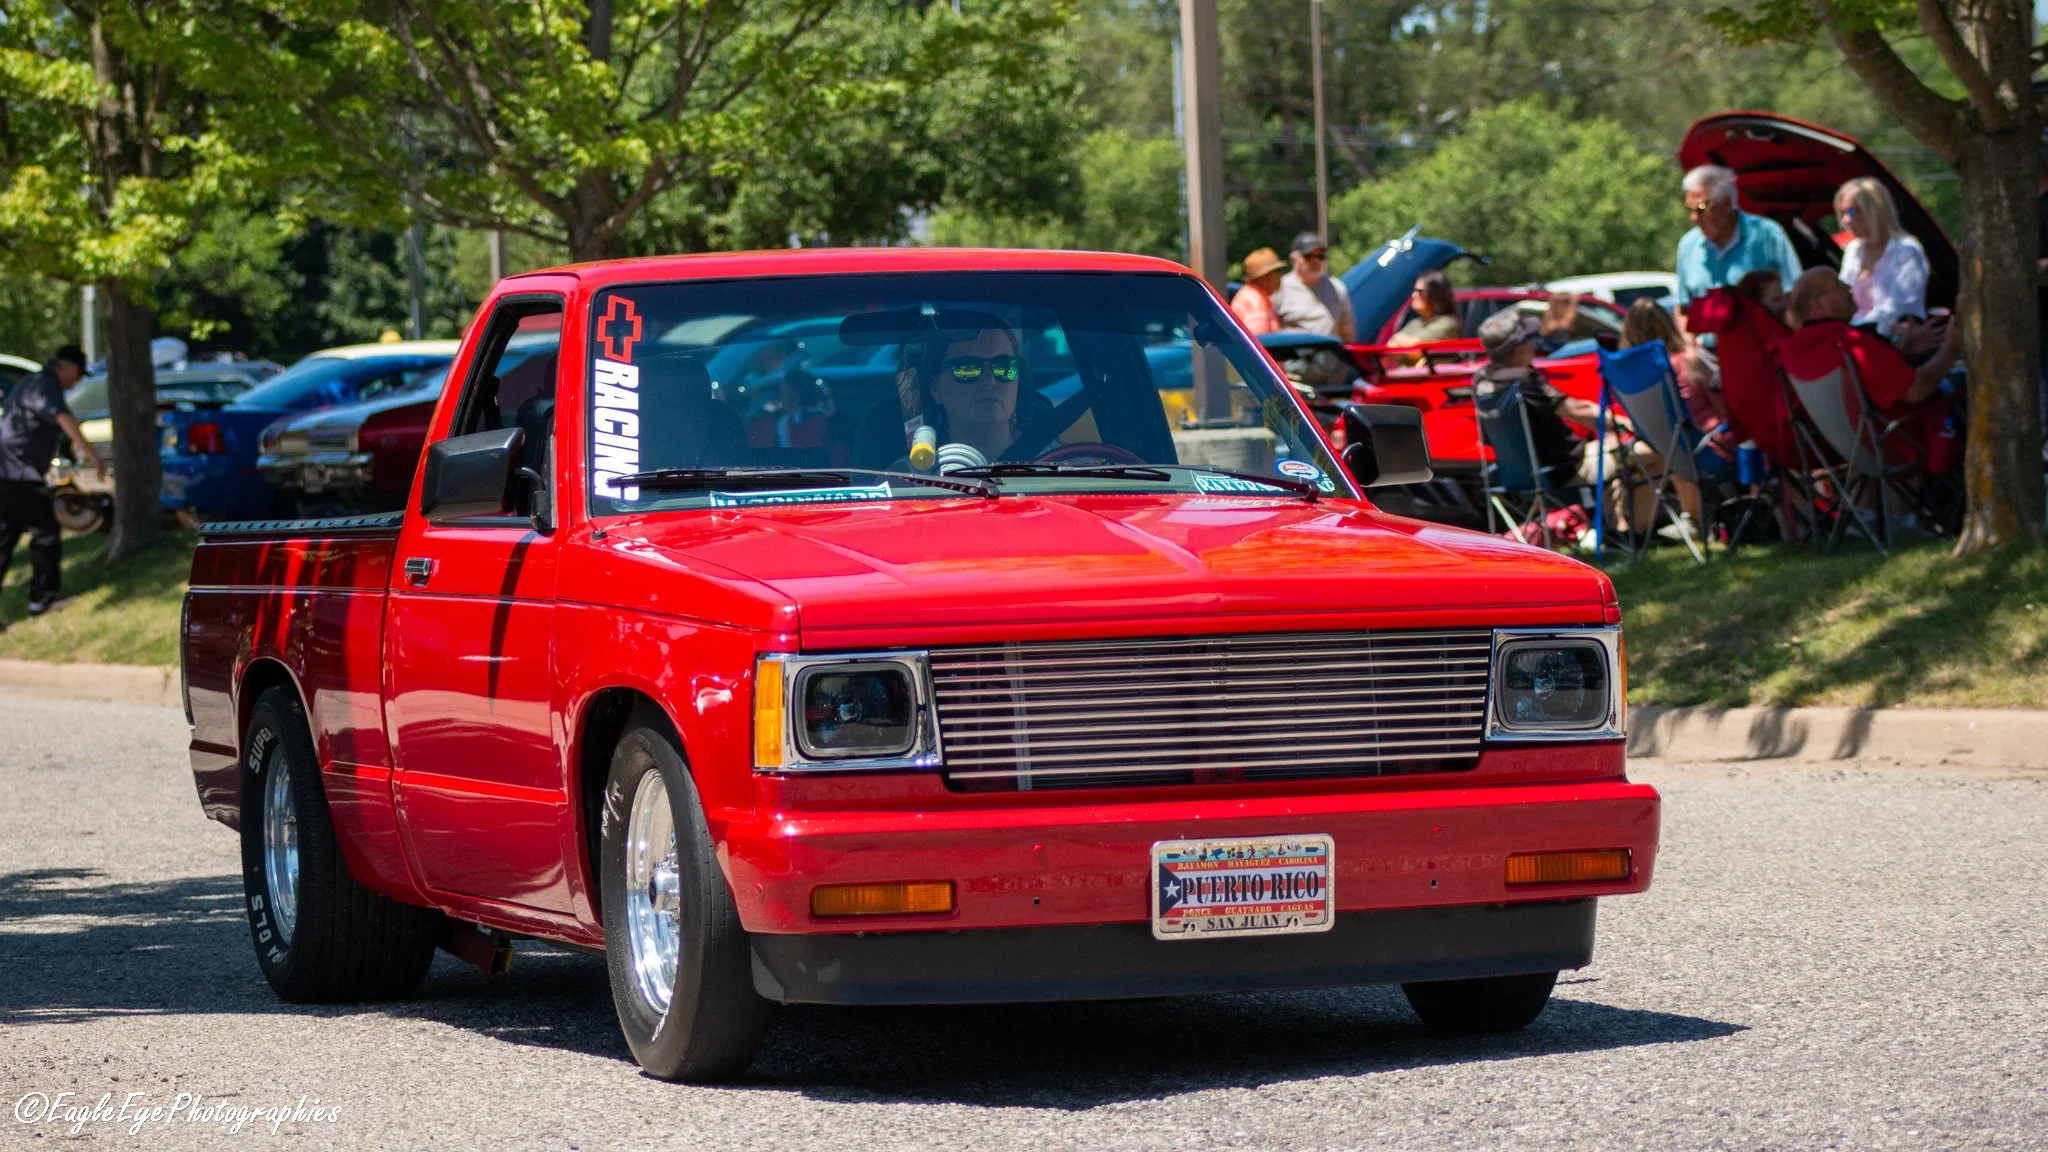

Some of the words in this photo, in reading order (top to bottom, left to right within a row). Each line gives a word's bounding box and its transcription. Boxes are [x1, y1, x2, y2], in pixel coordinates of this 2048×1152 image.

[249, 727, 274, 774] SUPER
[1177, 861, 1219, 870] BAYAMON
[1227, 858, 1271, 868] MAYAGUEZ
[1278, 856, 1318, 865] CAROLINA
[1180, 873, 1264, 904] PUERTO
[1270, 871, 1319, 900] RICO
[1182, 908, 1212, 917] PONCE
[1280, 903, 1314, 912] CAGUAS
[1207, 916, 1235, 929] SAN
[1241, 914, 1280, 927] JUAN
